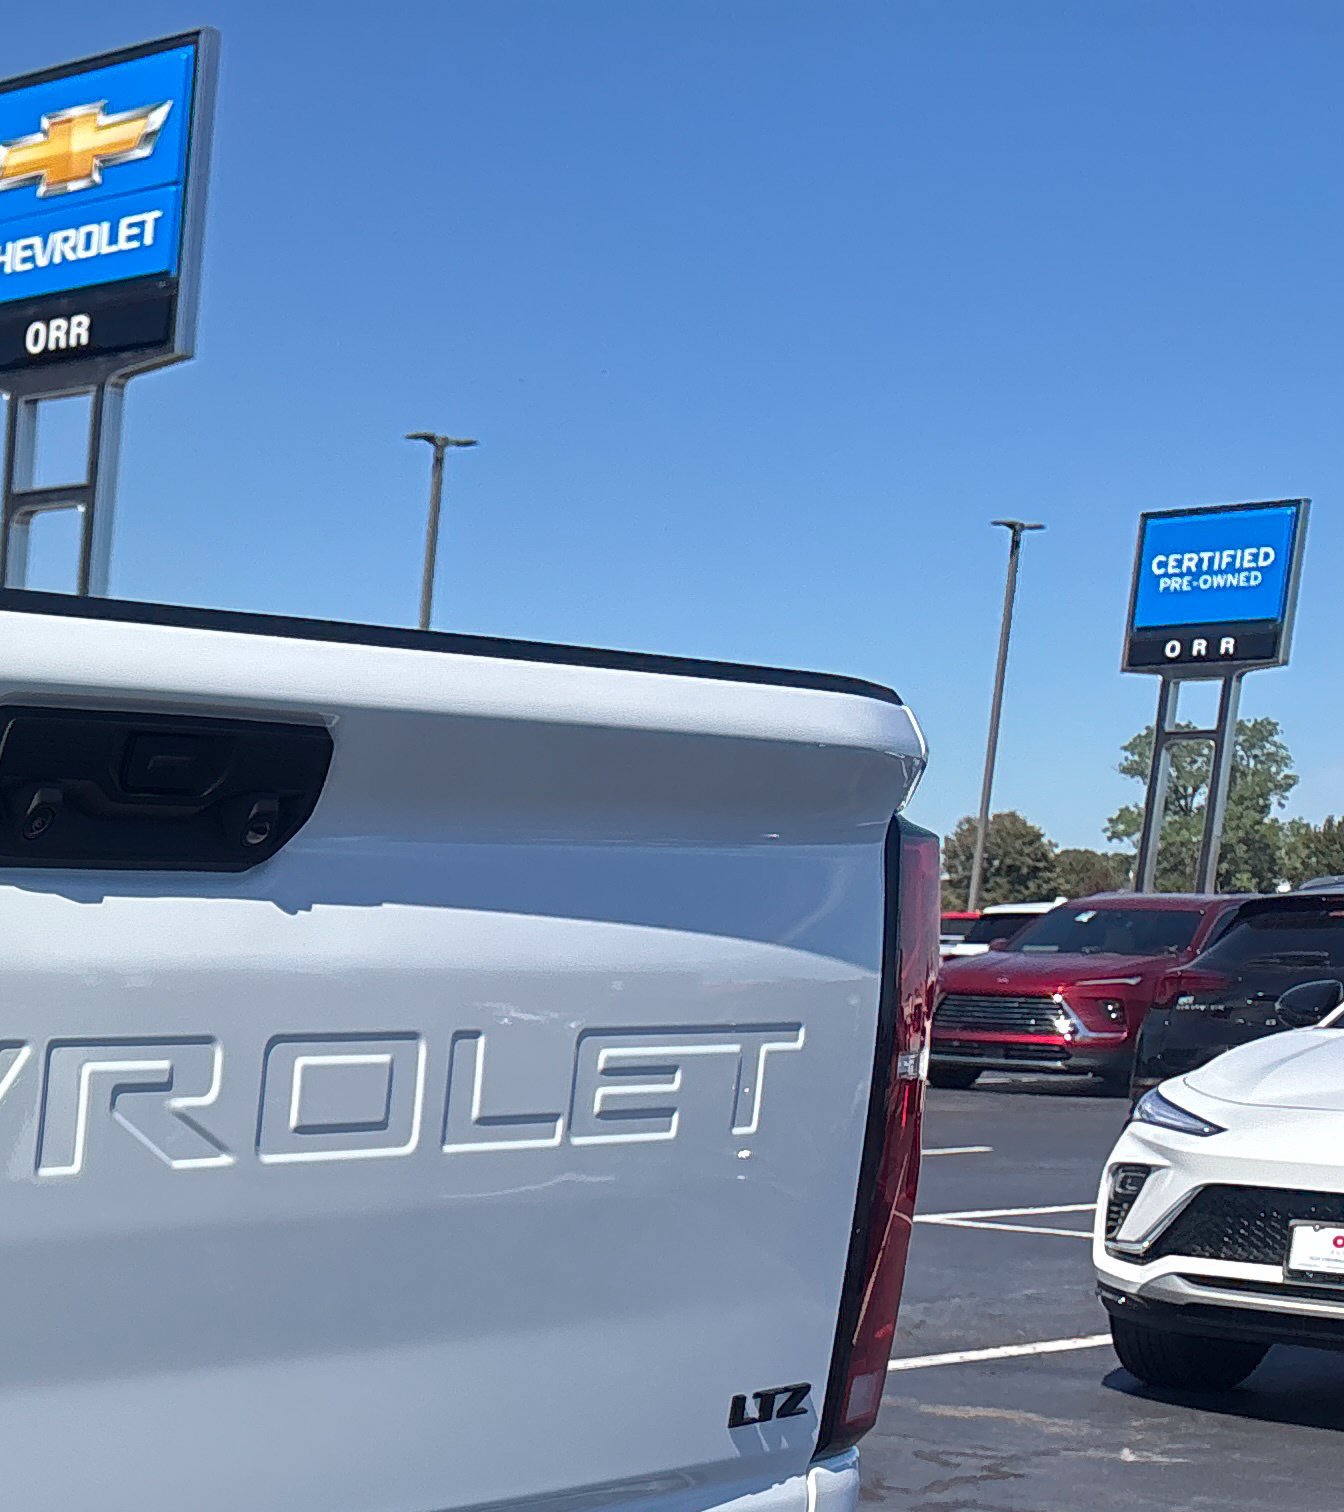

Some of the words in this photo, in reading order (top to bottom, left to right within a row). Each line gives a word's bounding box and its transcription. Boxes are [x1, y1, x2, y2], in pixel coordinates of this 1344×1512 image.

[24, 313, 92, 355] ORR
[1151, 546, 1276, 575] CERTIFIED
[1158, 570, 1263, 593] PRE-OWNED
[727, 1382, 811, 1429] LTZ
